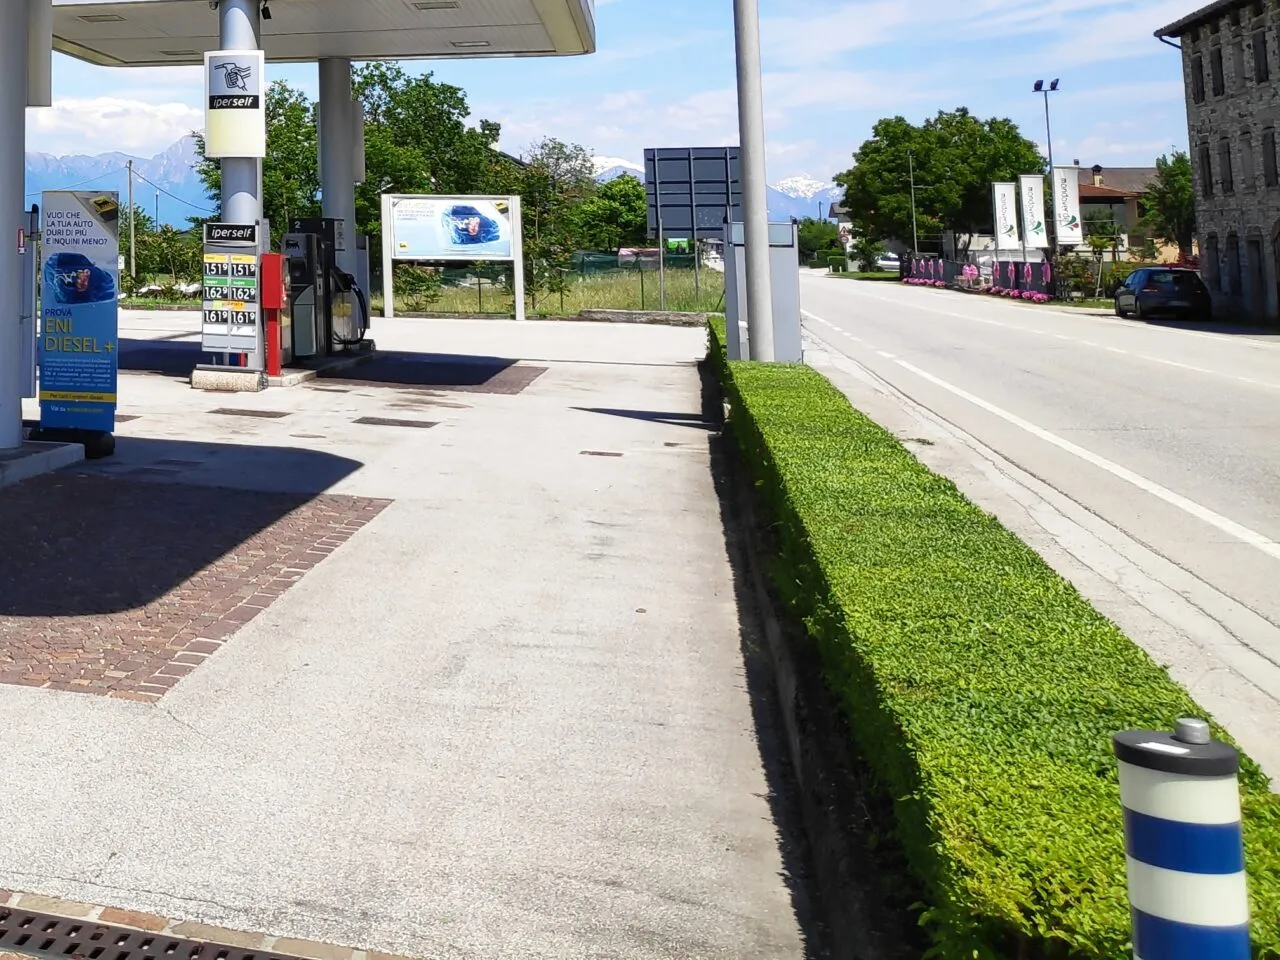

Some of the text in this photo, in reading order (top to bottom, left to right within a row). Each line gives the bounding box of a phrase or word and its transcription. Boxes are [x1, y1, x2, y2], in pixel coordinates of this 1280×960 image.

[213, 96, 254, 108] iperself
[46, 211, 81, 219] VUOI CHE
[46, 220, 56, 228] LA
[294, 221, 301, 229] 2
[321, 221, 326, 229] 1
[212, 226, 252, 238] iperself
[52, 238, 80, 246] INQUINI
[81, 238, 108, 246] MENO?
[45, 308, 72, 316] PROVA
[45, 318, 72, 333] ENI
[45, 336, 102, 352] DIESEL
